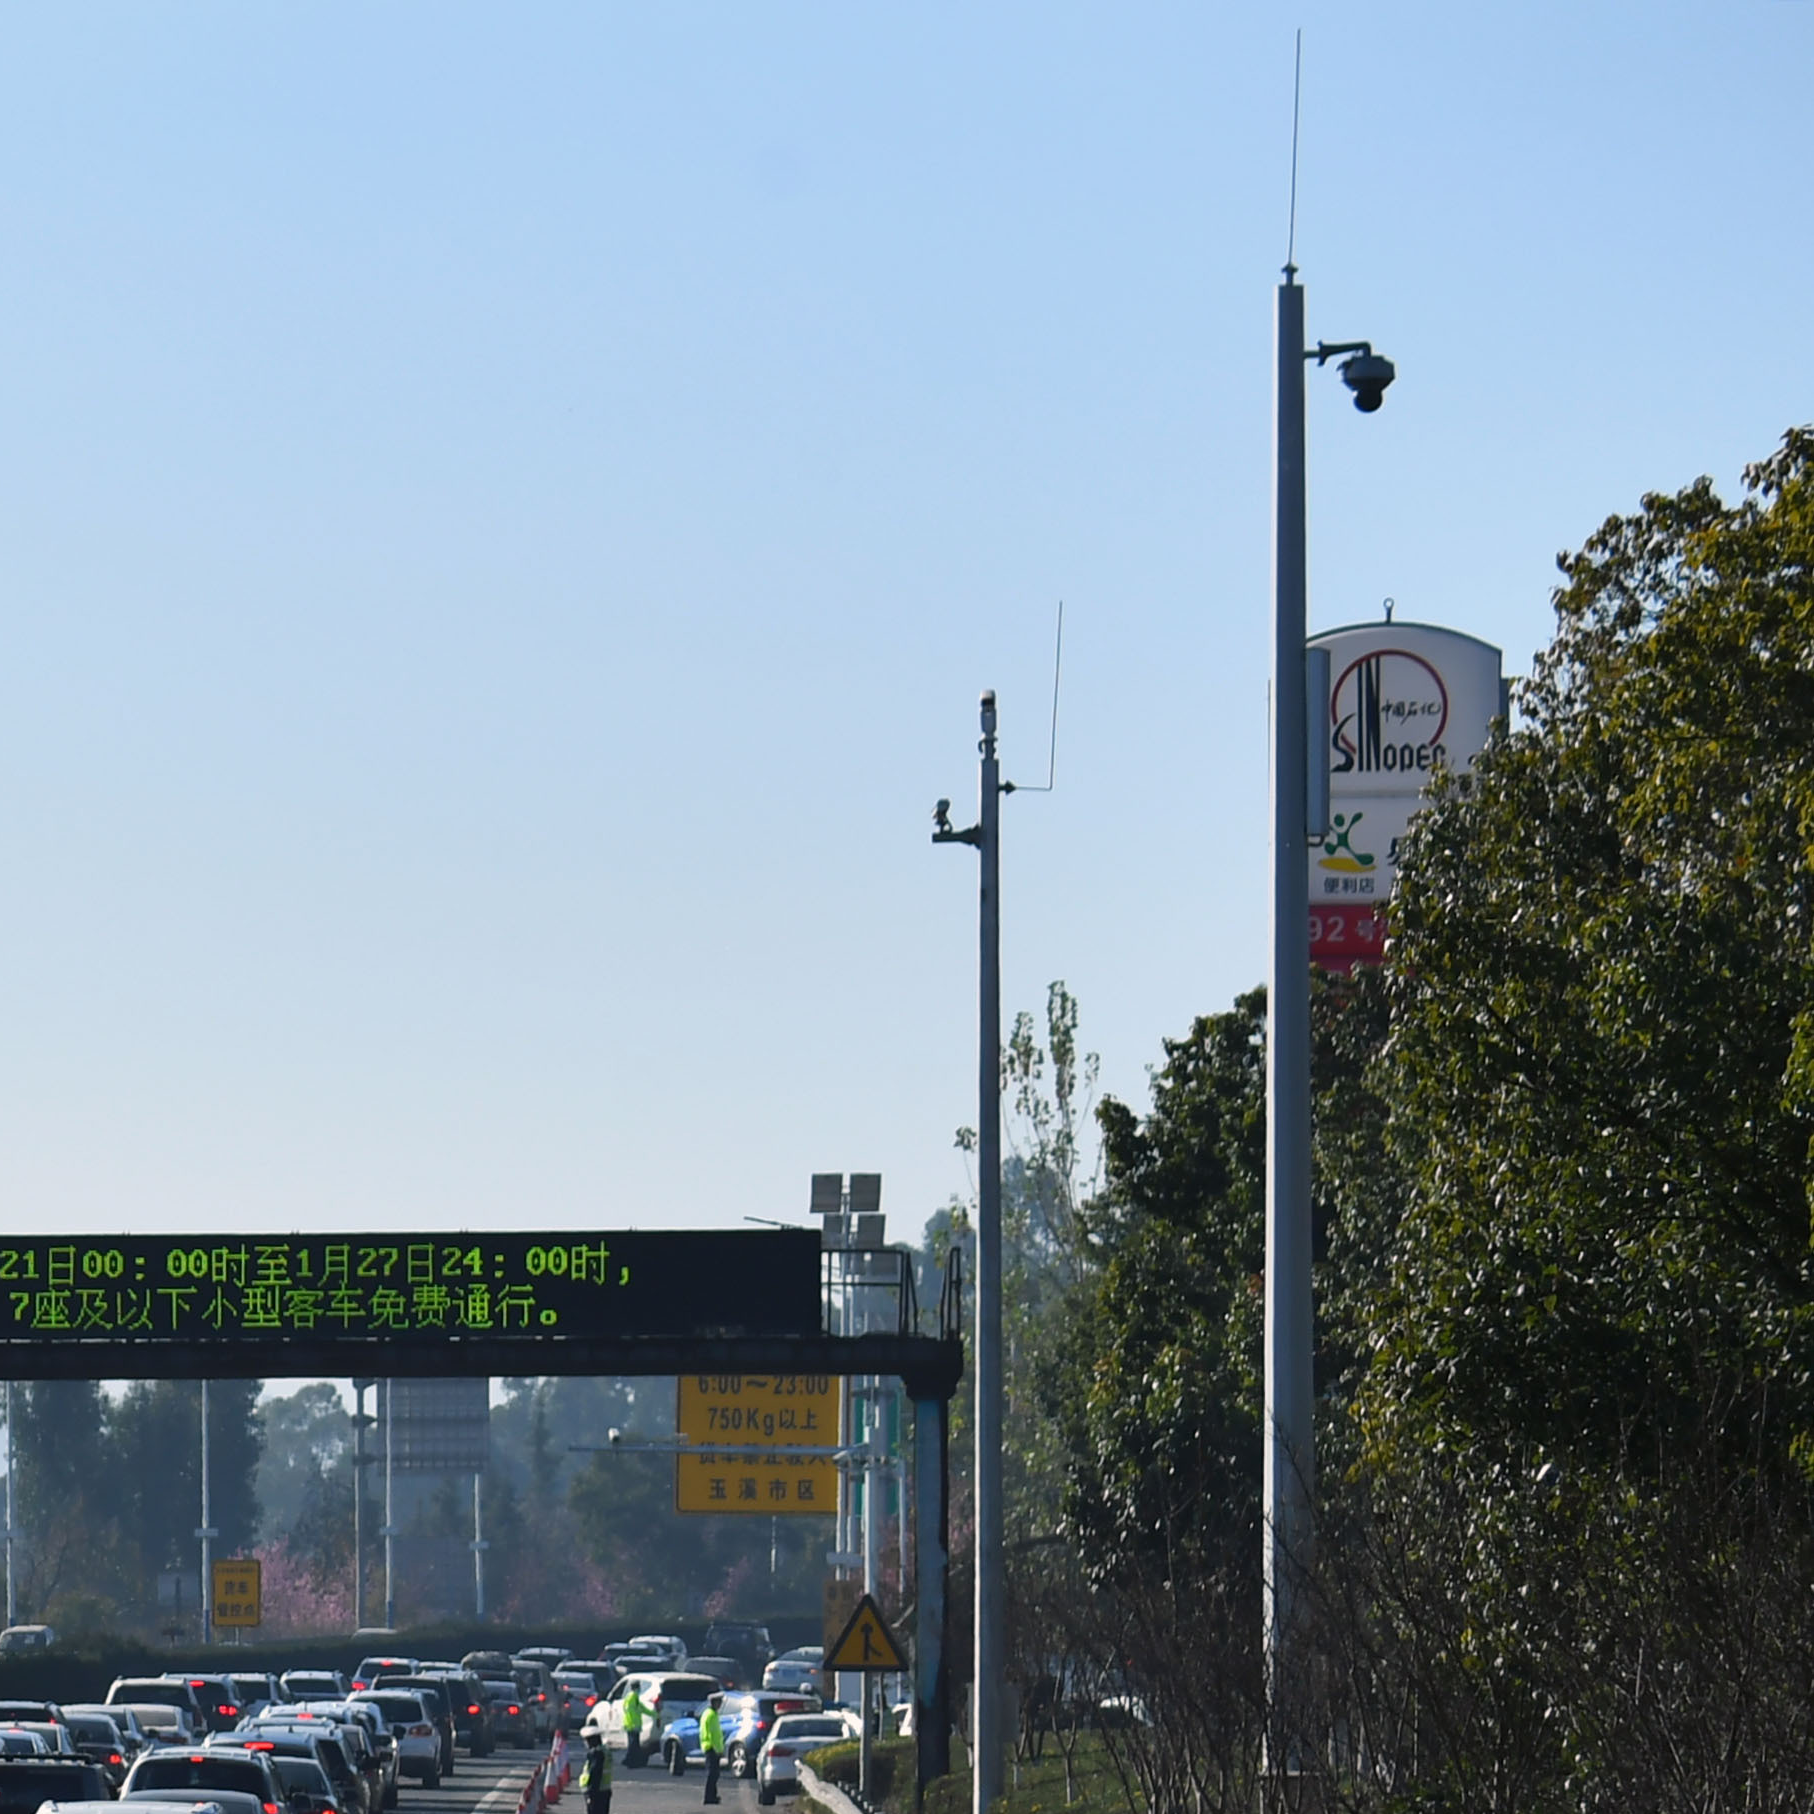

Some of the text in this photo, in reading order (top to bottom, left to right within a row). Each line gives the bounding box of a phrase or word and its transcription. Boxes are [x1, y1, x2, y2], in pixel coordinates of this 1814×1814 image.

[1323, 877, 1375, 893] 便利店
[8, 1283, 558, 1331] 7座及以下小型客车免费通行。
[708, 1478, 815, 1501] 玉溪市区
